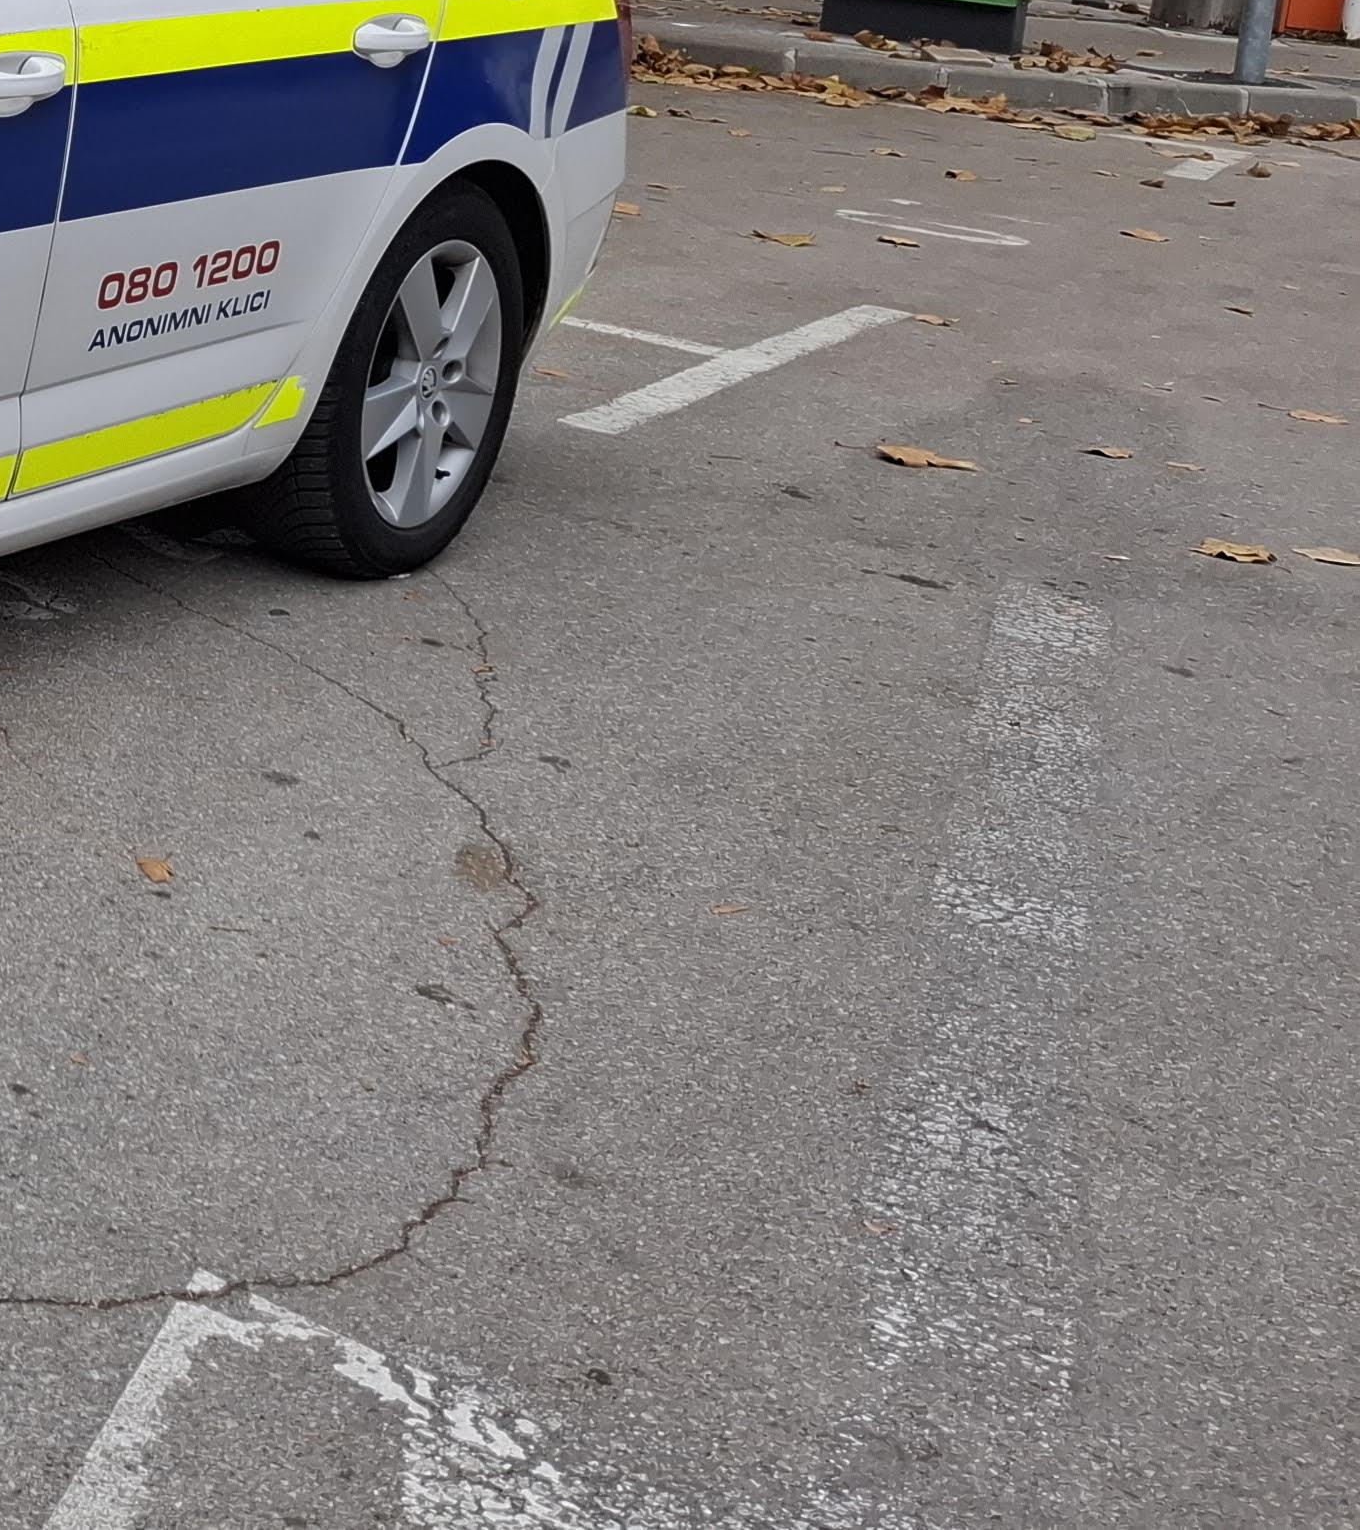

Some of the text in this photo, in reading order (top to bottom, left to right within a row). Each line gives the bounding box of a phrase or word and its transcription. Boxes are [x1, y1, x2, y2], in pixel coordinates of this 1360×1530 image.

[96, 239, 282, 311] 080 1200
[87, 288, 272, 353] ANONIMNI KLICI
